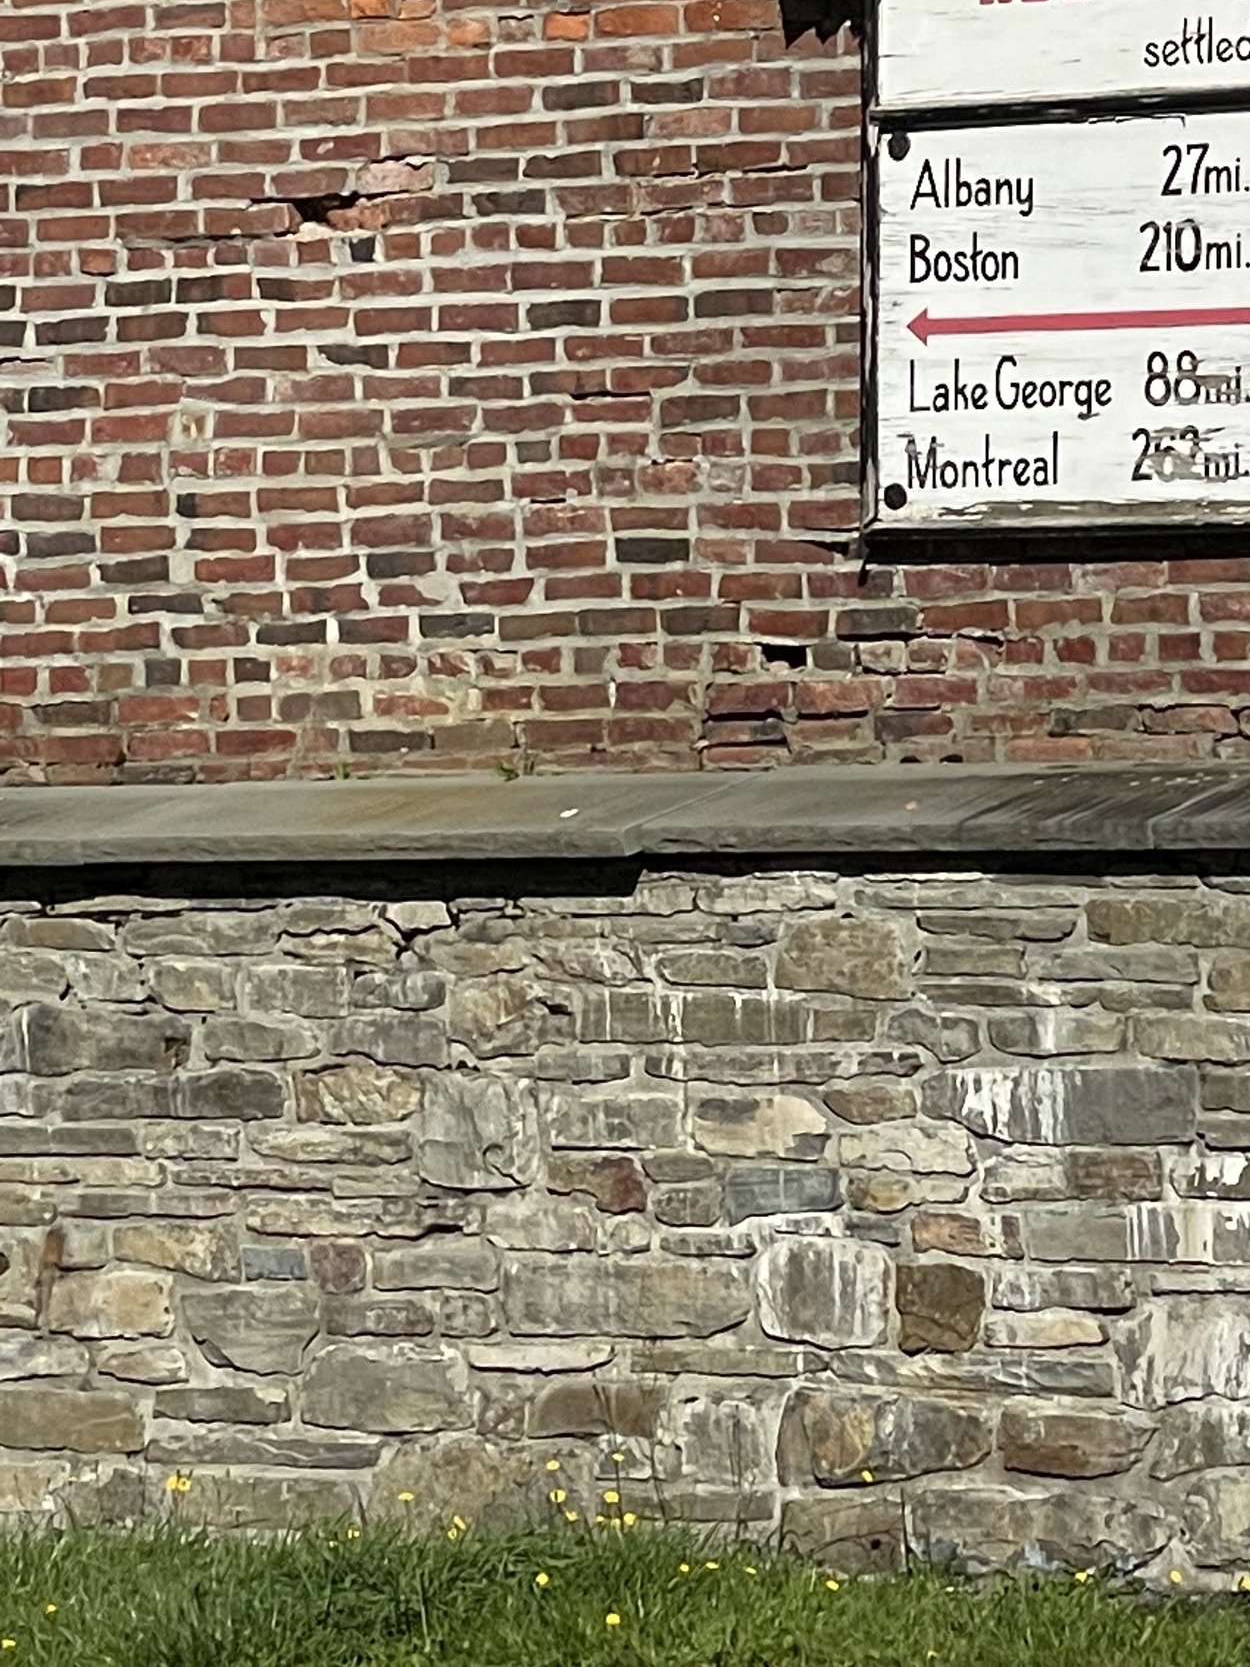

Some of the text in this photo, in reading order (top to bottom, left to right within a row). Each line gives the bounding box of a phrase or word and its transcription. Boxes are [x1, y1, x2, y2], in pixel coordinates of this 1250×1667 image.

[909, 157, 1035, 217] Albany
[908, 230, 1020, 284] Boston
[909, 358, 988, 413] Lake
[995, 354, 1112, 417] George
[906, 430, 1059, 490] Montreal
